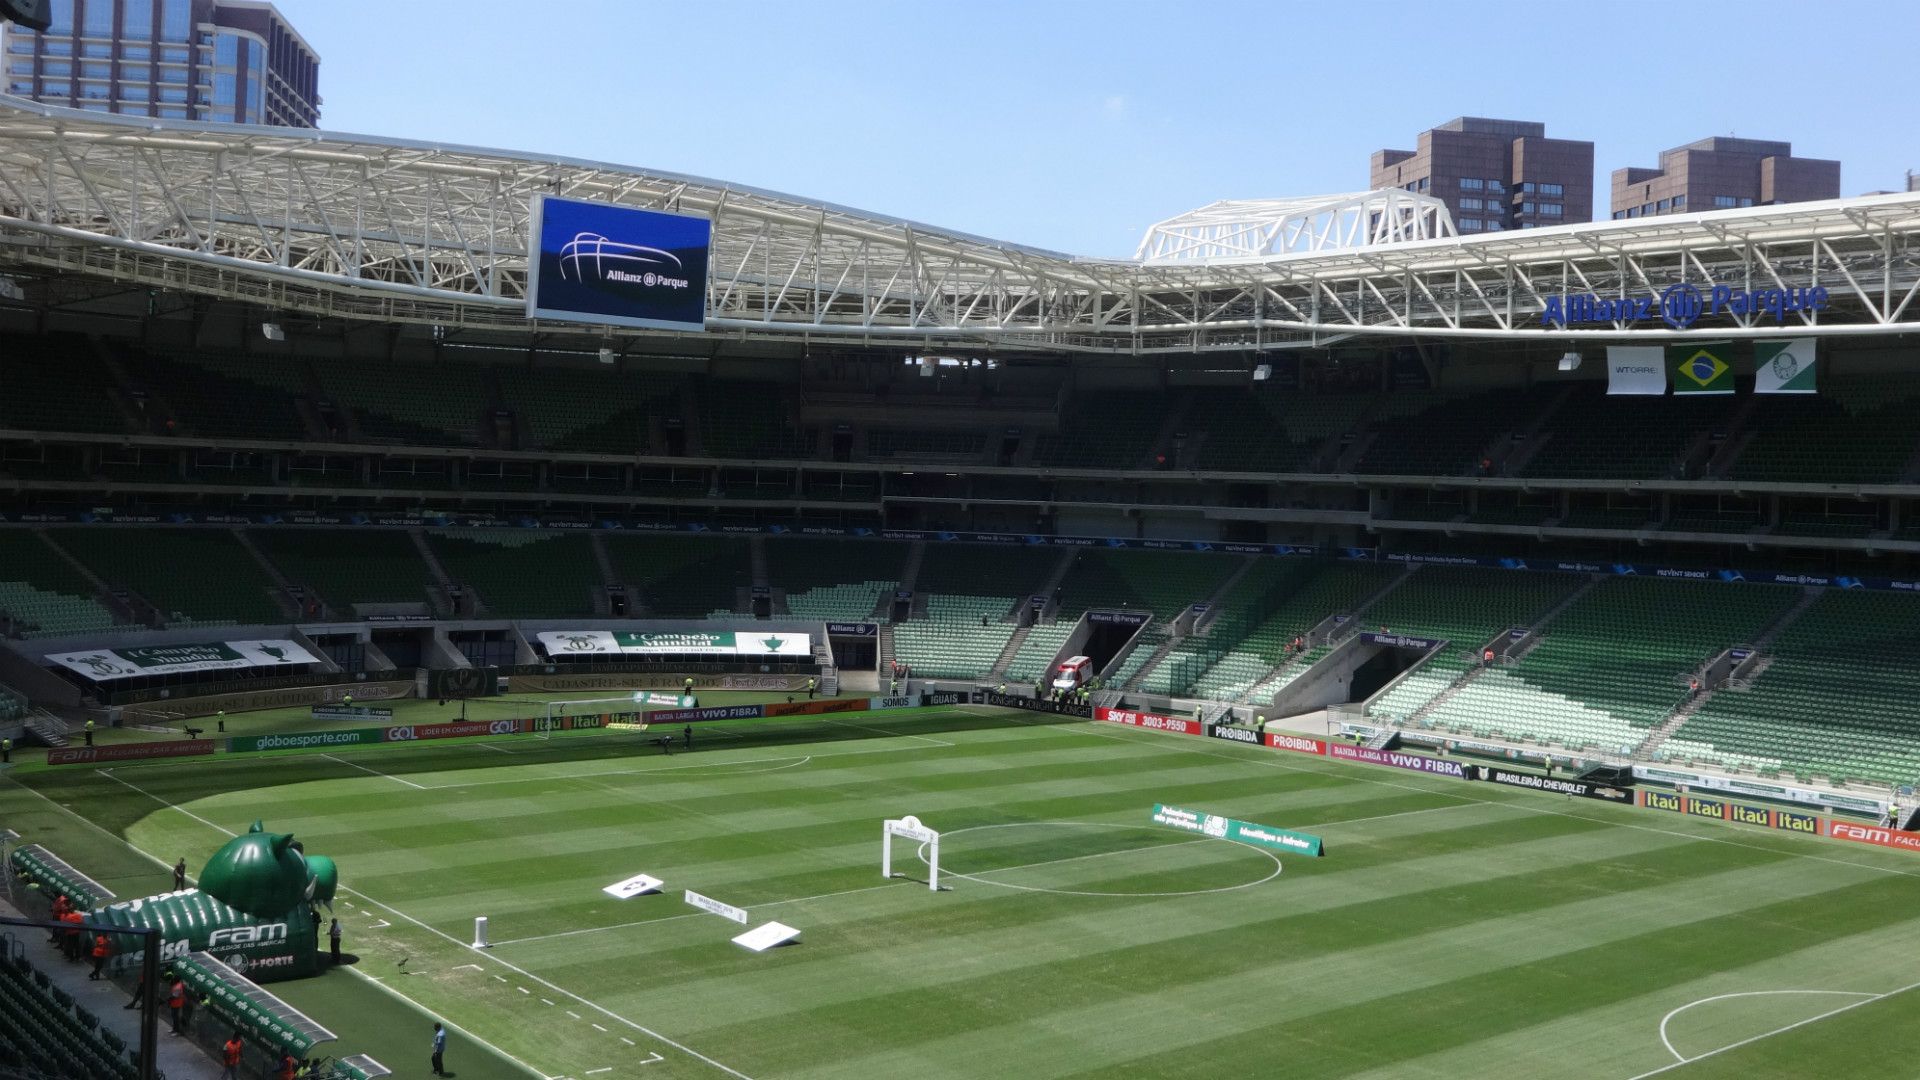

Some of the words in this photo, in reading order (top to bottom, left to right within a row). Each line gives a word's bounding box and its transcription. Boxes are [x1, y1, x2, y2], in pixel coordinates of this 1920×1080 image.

[606, 270, 642, 283] Allianz
[657, 276, 688, 289] Parque
[1541, 294, 1654, 325] Allianz
[1711, 284, 1829, 321] Parque
[1121, 616, 1140, 624] Parque
[830, 624, 855, 633] Allianz
[640, 632, 721, 643] Campeão
[642, 639, 713, 647] Mundial
[1374, 636, 1396, 644] Allianz
[1405, 639, 1427, 648] Parque
[882, 697, 909, 708] SOMOS
[930, 692, 959, 704] IGUAIS
[573, 713, 600, 727] Itaú
[702, 710, 727, 719] VIVO
[730, 707, 758, 717] FIBRA
[490, 720, 519, 734] GOL
[534, 716, 562, 731] Itaú
[1141, 716, 1187, 732] 3003-9550
[389, 726, 418, 740] GOL
[256, 731, 360, 750] globoesporte.com
[1334, 746, 1358, 758] BANDA
[1358, 751, 1382, 762] LARGA
[1390, 754, 1422, 769] VIVO
[1425, 758, 1463, 776] FIBRA
[1496, 771, 1543, 788] BRASILEIRÃO
[1543, 779, 1588, 795] CHEVROLET
[1646, 792, 1679, 810] Itaú
[1688, 798, 1723, 818] Itaú
[1733, 806, 1768, 825] Itaú
[1778, 812, 1815, 832] Itaú
